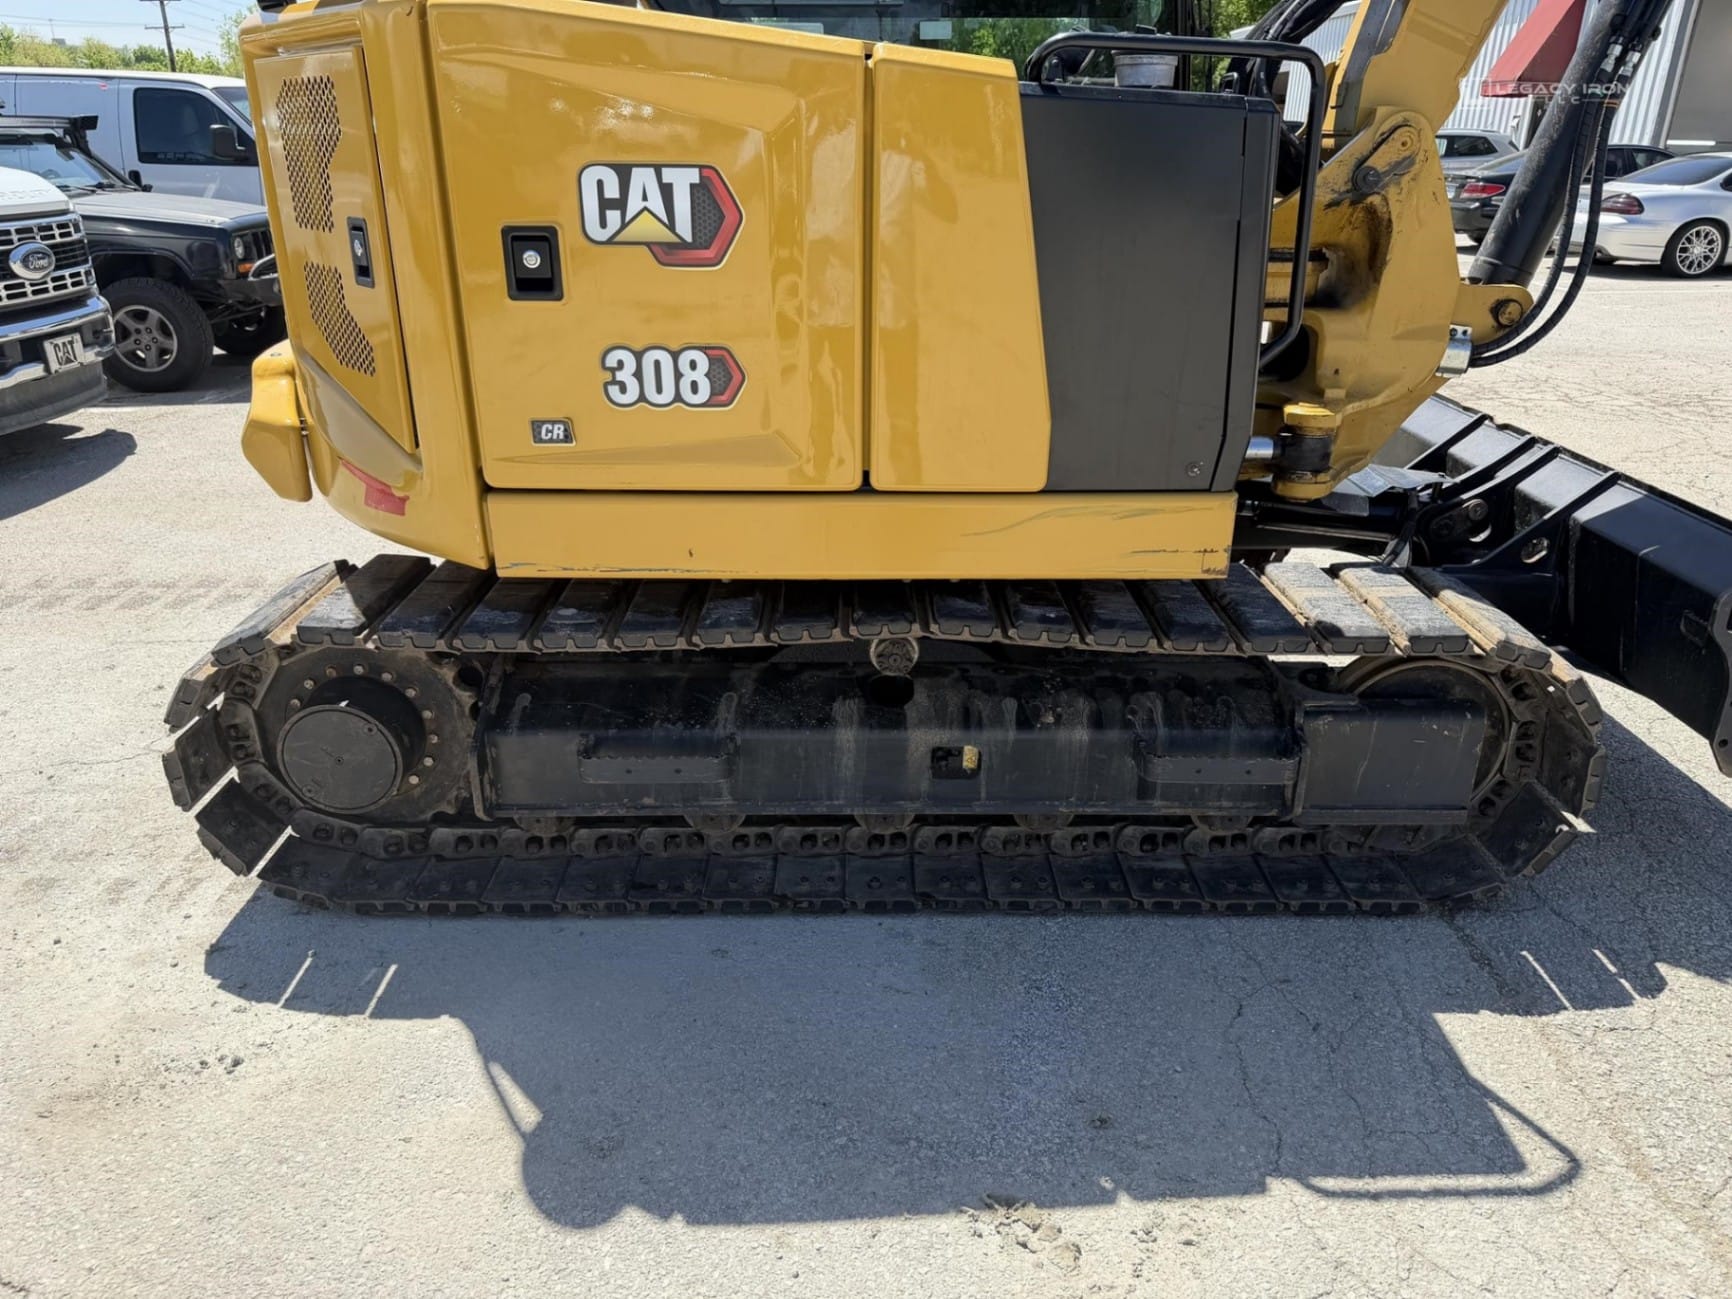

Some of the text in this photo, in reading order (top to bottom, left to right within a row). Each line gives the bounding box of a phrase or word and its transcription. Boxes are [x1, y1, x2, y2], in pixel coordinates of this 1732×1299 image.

[580, 165, 700, 243] CAT
[28, 254, 49, 269] Ford
[53, 339, 78, 366] CAT
[605, 349, 711, 405] 308
[541, 424, 565, 440] CR
